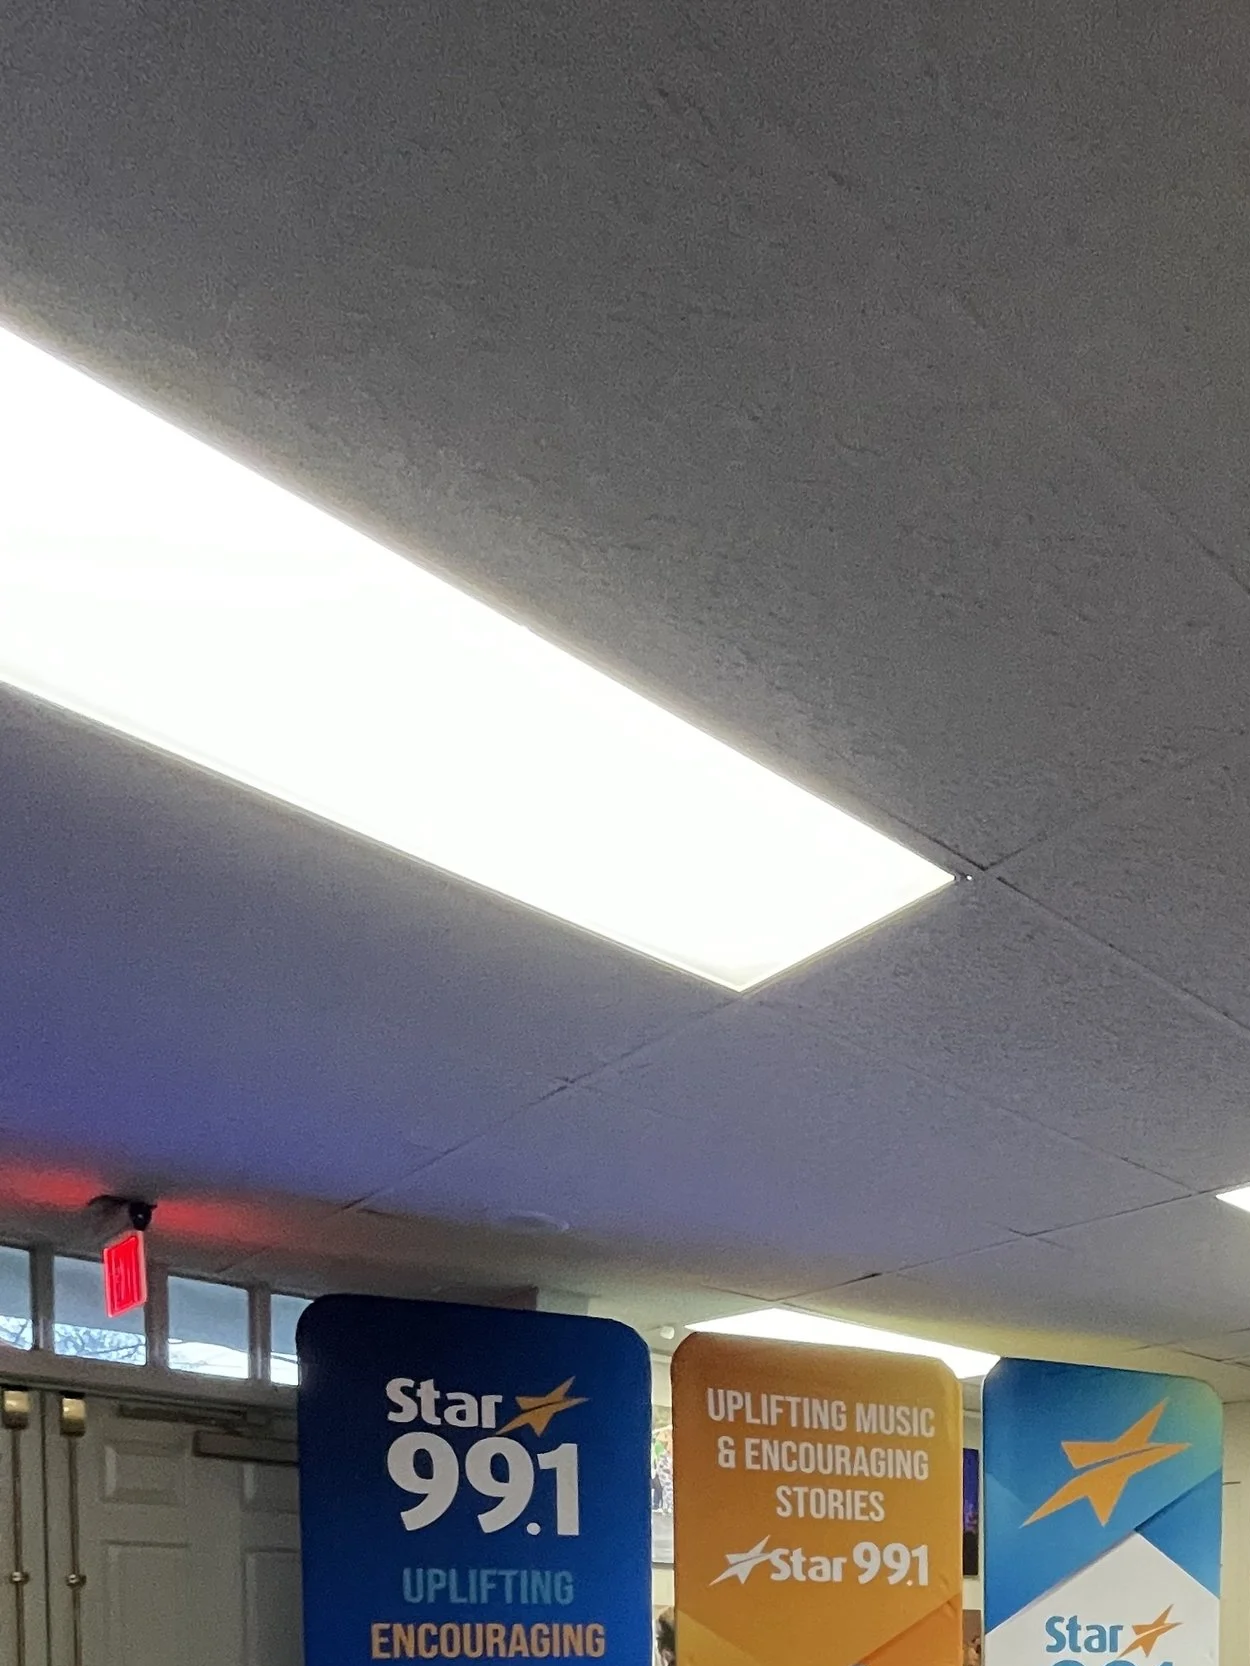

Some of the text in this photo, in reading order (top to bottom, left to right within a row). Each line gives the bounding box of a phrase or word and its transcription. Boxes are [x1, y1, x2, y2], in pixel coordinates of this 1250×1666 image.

[386, 1377, 503, 1429] Star
[707, 1388, 935, 1438] UPLIFTING MUSIC
[718, 1436, 928, 1481] & ENCOURAGING
[387, 1432, 579, 1536] 99.1
[776, 1485, 885, 1522] STORIES
[770, 1542, 928, 1586] Star 99.1
[402, 1568, 574, 1605] UPLIFTING
[371, 1623, 605, 1659] ENCOURAGING
[1045, 1615, 1123, 1653] Star
